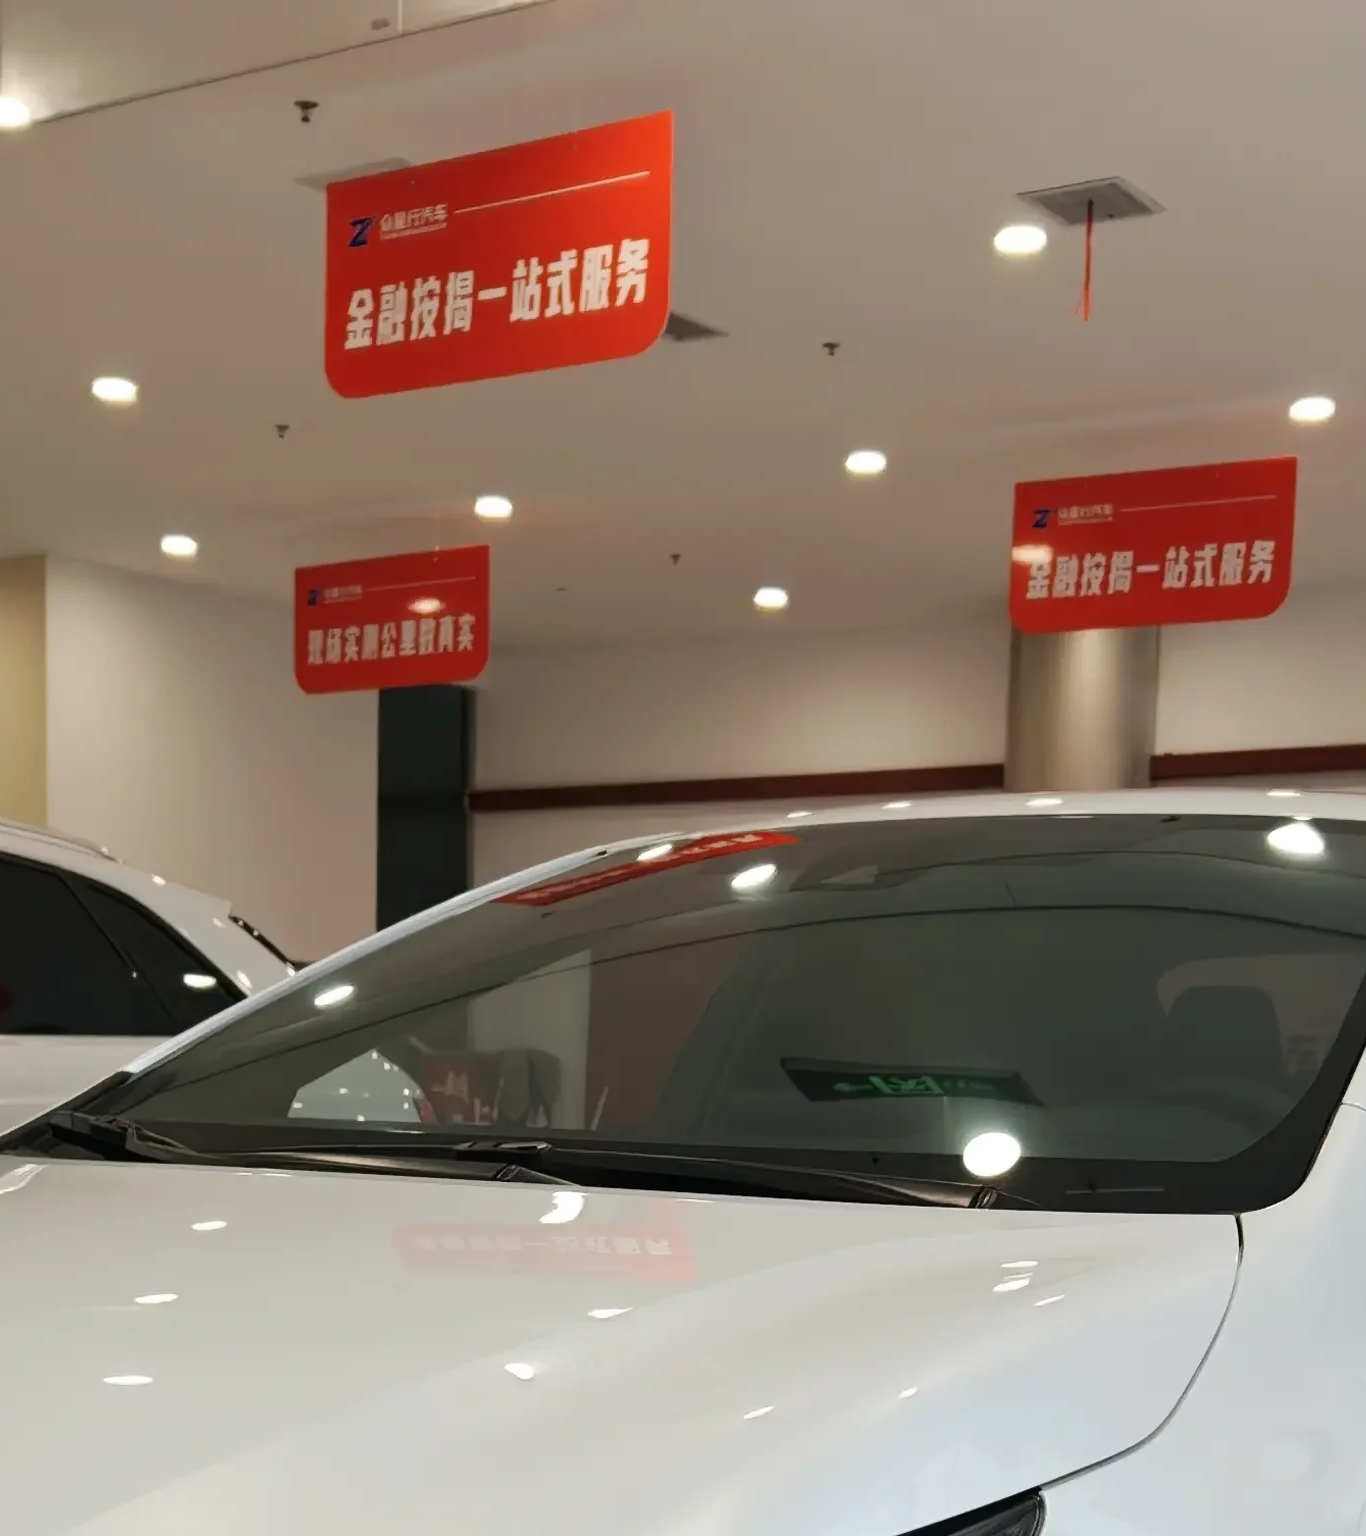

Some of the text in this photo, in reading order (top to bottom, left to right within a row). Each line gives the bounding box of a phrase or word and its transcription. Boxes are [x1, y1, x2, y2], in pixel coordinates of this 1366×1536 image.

[344, 238, 650, 350] 金融按揭一站式服务
[1026, 540, 1276, 600] 金融按揭一站式服务
